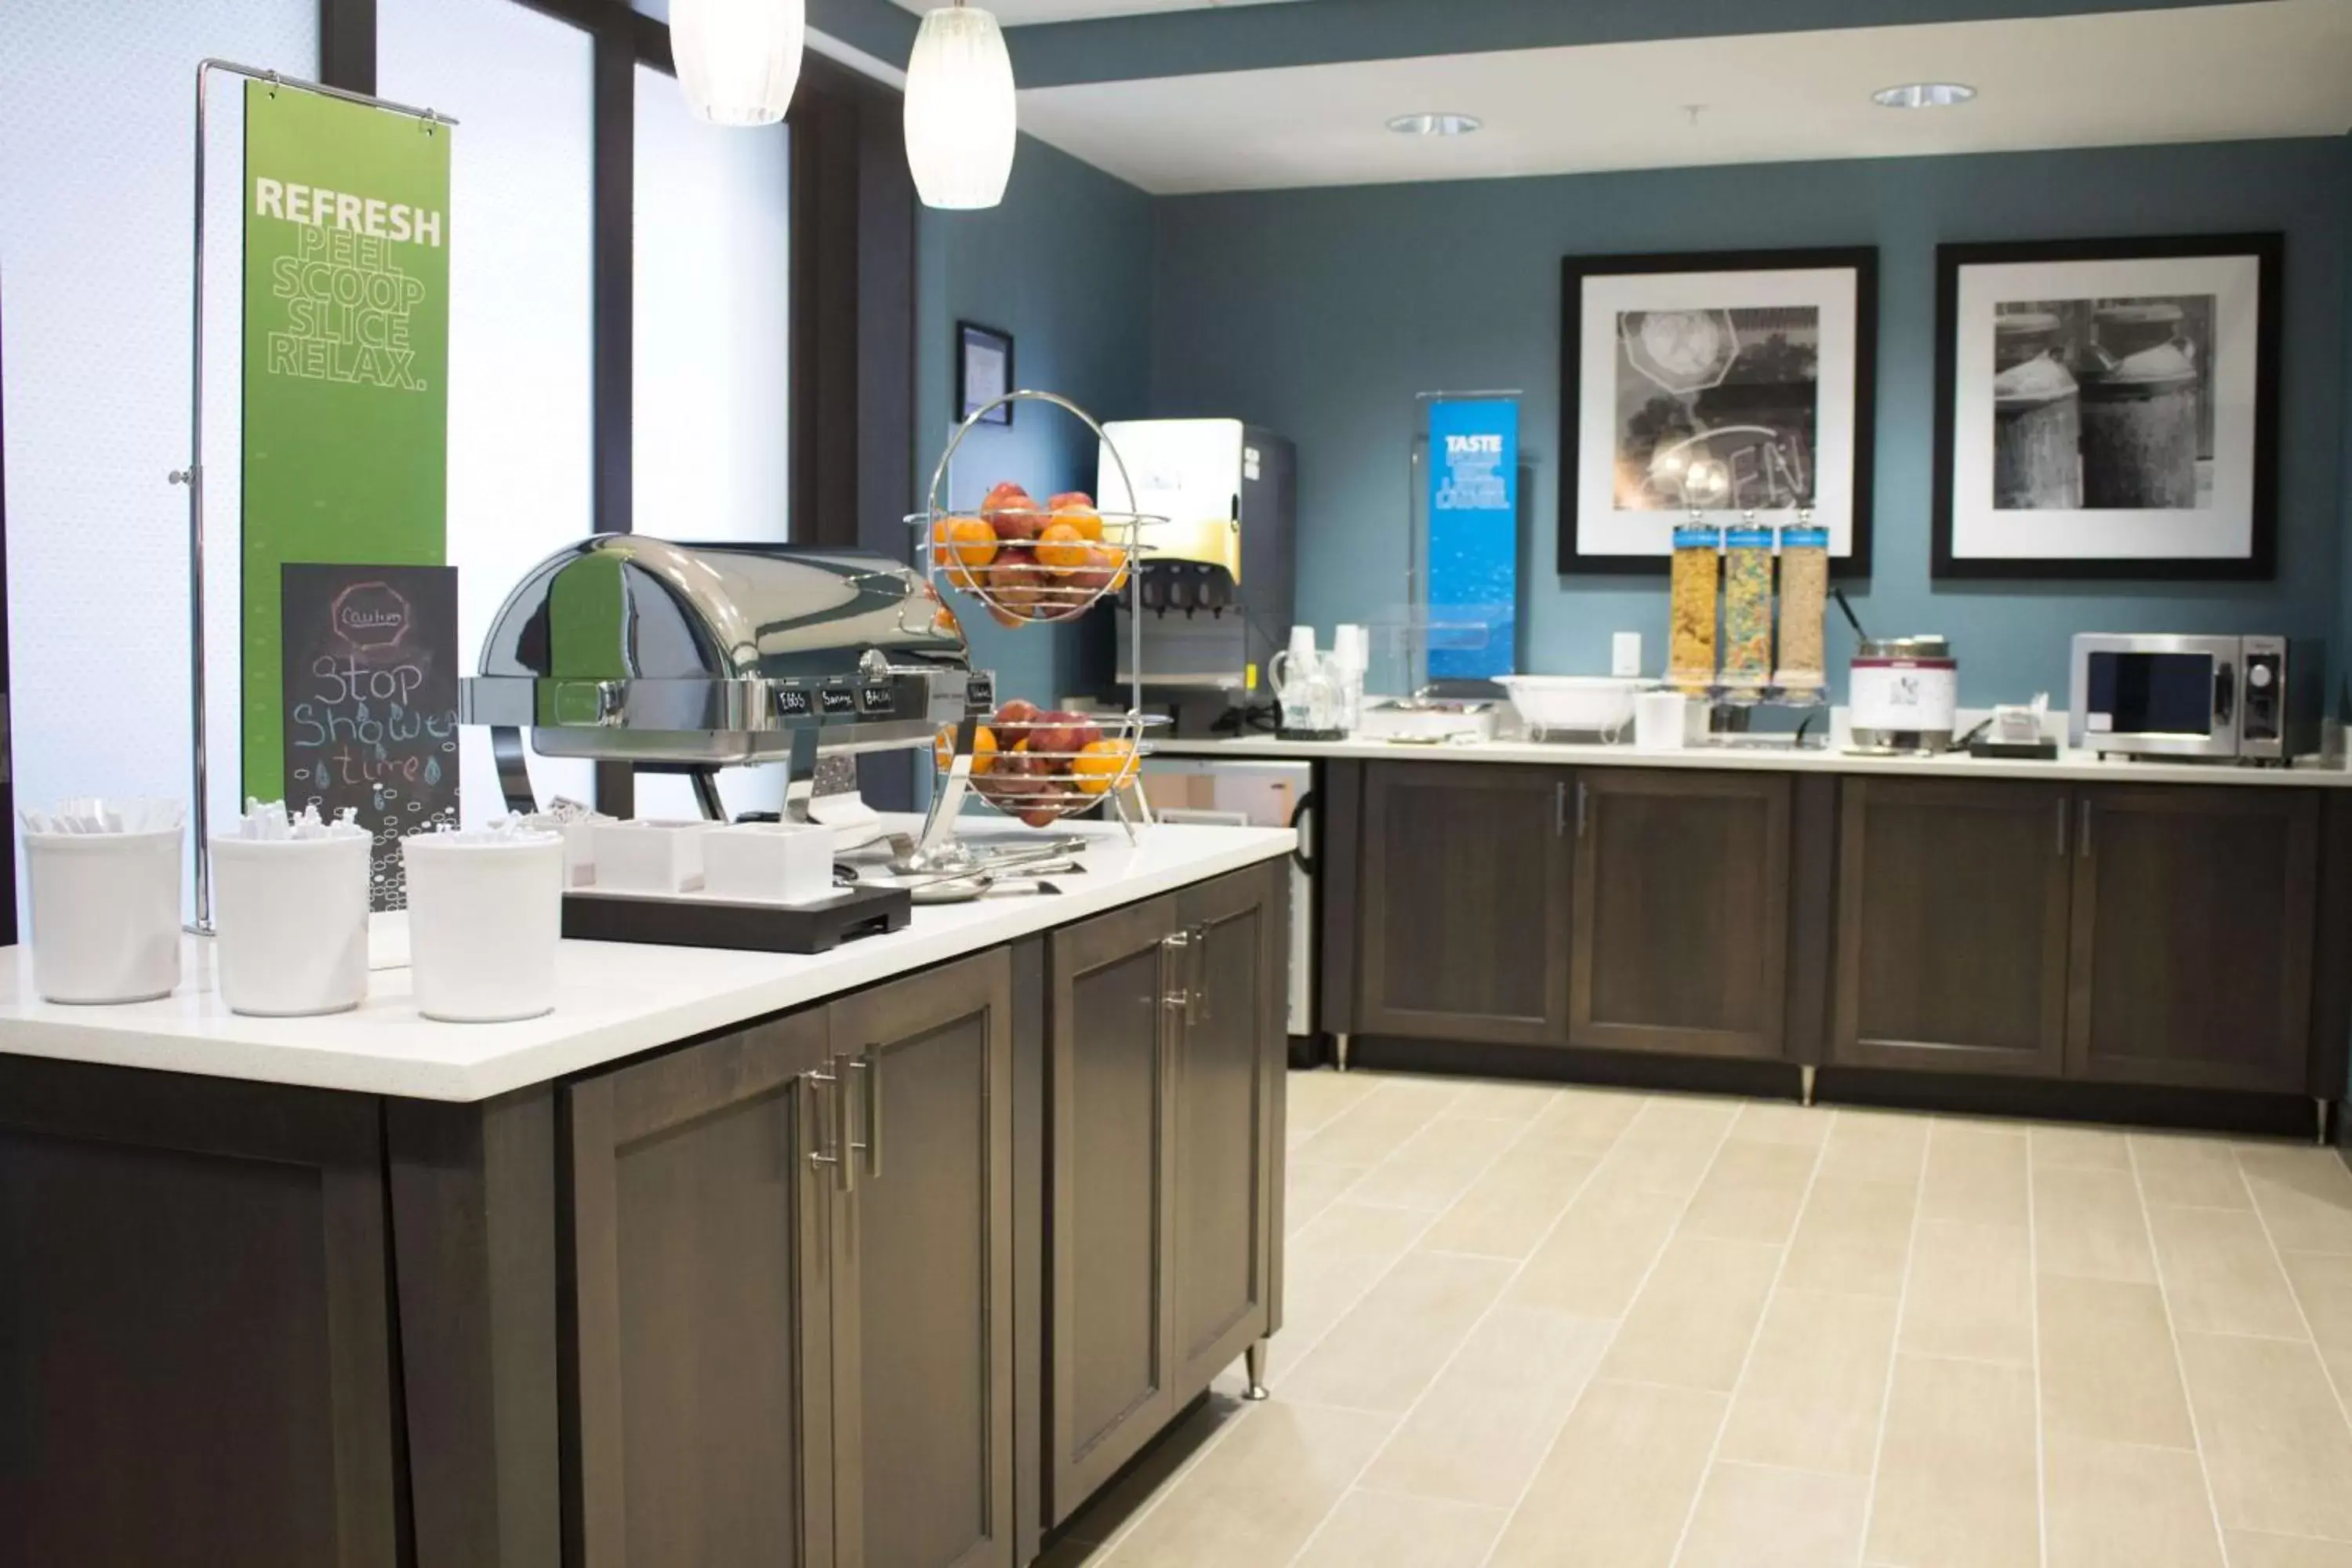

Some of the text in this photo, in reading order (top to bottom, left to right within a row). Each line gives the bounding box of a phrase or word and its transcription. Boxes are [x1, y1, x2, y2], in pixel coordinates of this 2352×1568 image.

[256, 176, 441, 247] REFRESH
[298, 223, 403, 276] PEEL
[274, 256, 426, 315] SCOOP
[288, 297, 410, 352] SLICE
[268, 331, 427, 391] RELAX.
[1445, 434, 1503, 452] TASTE
